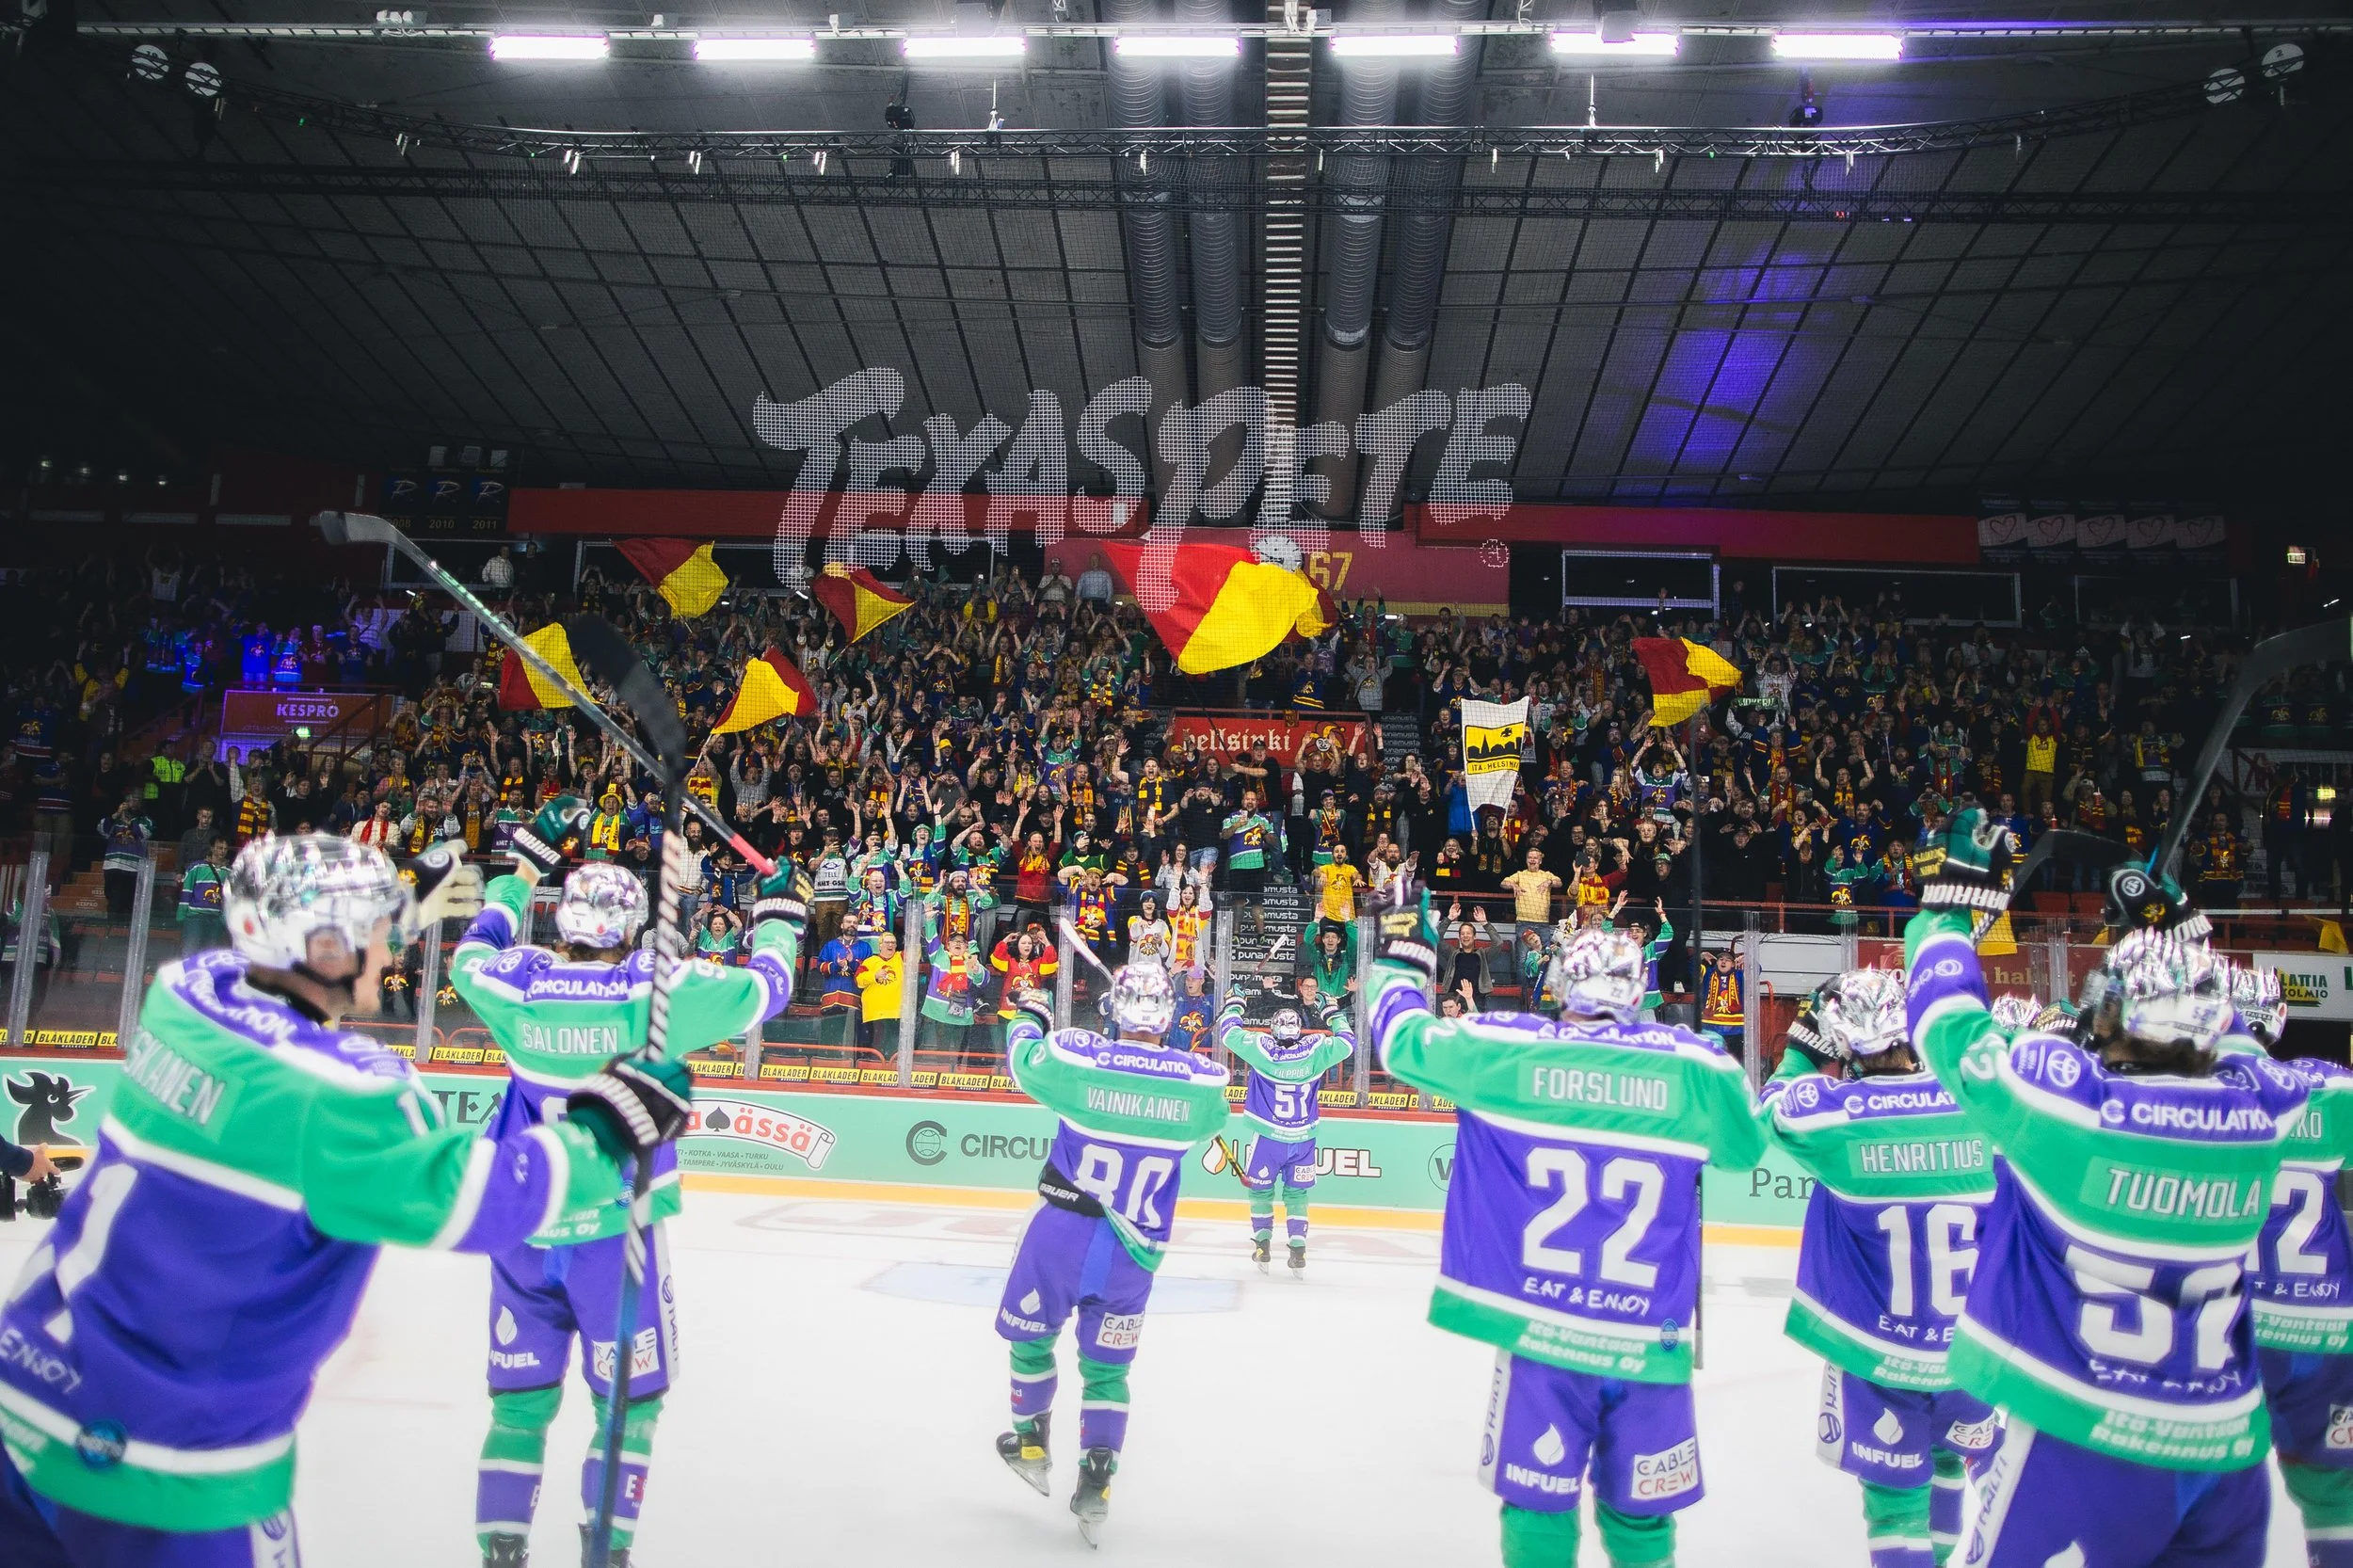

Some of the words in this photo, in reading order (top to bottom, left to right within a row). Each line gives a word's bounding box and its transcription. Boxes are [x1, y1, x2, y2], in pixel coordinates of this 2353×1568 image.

[428, 520, 455, 529] 2010
[472, 520, 497, 529] 2011
[277, 704, 340, 718] KESPRO
[521, 1022, 619, 1055] SALONEN
[1112, 1053, 1193, 1076] CIRCULATION
[1273, 1083, 1311, 1118] 51
[1533, 1066, 1669, 1112] FORSLUND
[1868, 1092, 1956, 1111] CIRCULAT
[1087, 1086, 1192, 1123] VAINIKAINEN
[733, 1107, 811, 1152] ässä
[689, 1149, 712, 1159] KOTKA
[716, 1151, 741, 1160] VAASA
[744, 1152, 770, 1160] TURKU
[960, 1133, 1052, 1161] CIRCU
[1860, 1139, 1983, 1174] HENRITIUS
[683, 1159, 716, 1168] TAMPERE
[764, 1162, 785, 1171] OULU
[1038, 1182, 1080, 1203] BAUER
[1074, 1143, 1175, 1229] 80
[2107, 1167, 2263, 1220] TUOMOLA
[1522, 1145, 1666, 1289] 22
[1877, 1203, 1979, 1317] 16
[1524, 1277, 1566, 1299] EAT
[1569, 1287, 1584, 1304] &
[1588, 1290, 1651, 1316] ENJOY
[1000, 1306, 1048, 1333] INFUEL
[1879, 1315, 1918, 1339] EAT
[1924, 1328, 1940, 1341] &
[1636, 1441, 1695, 1476] CABLE
[1851, 1440, 1924, 1469] INFUEL
[1506, 1463, 1580, 1495] INFUEL
[1638, 1467, 1695, 1496] CREW
